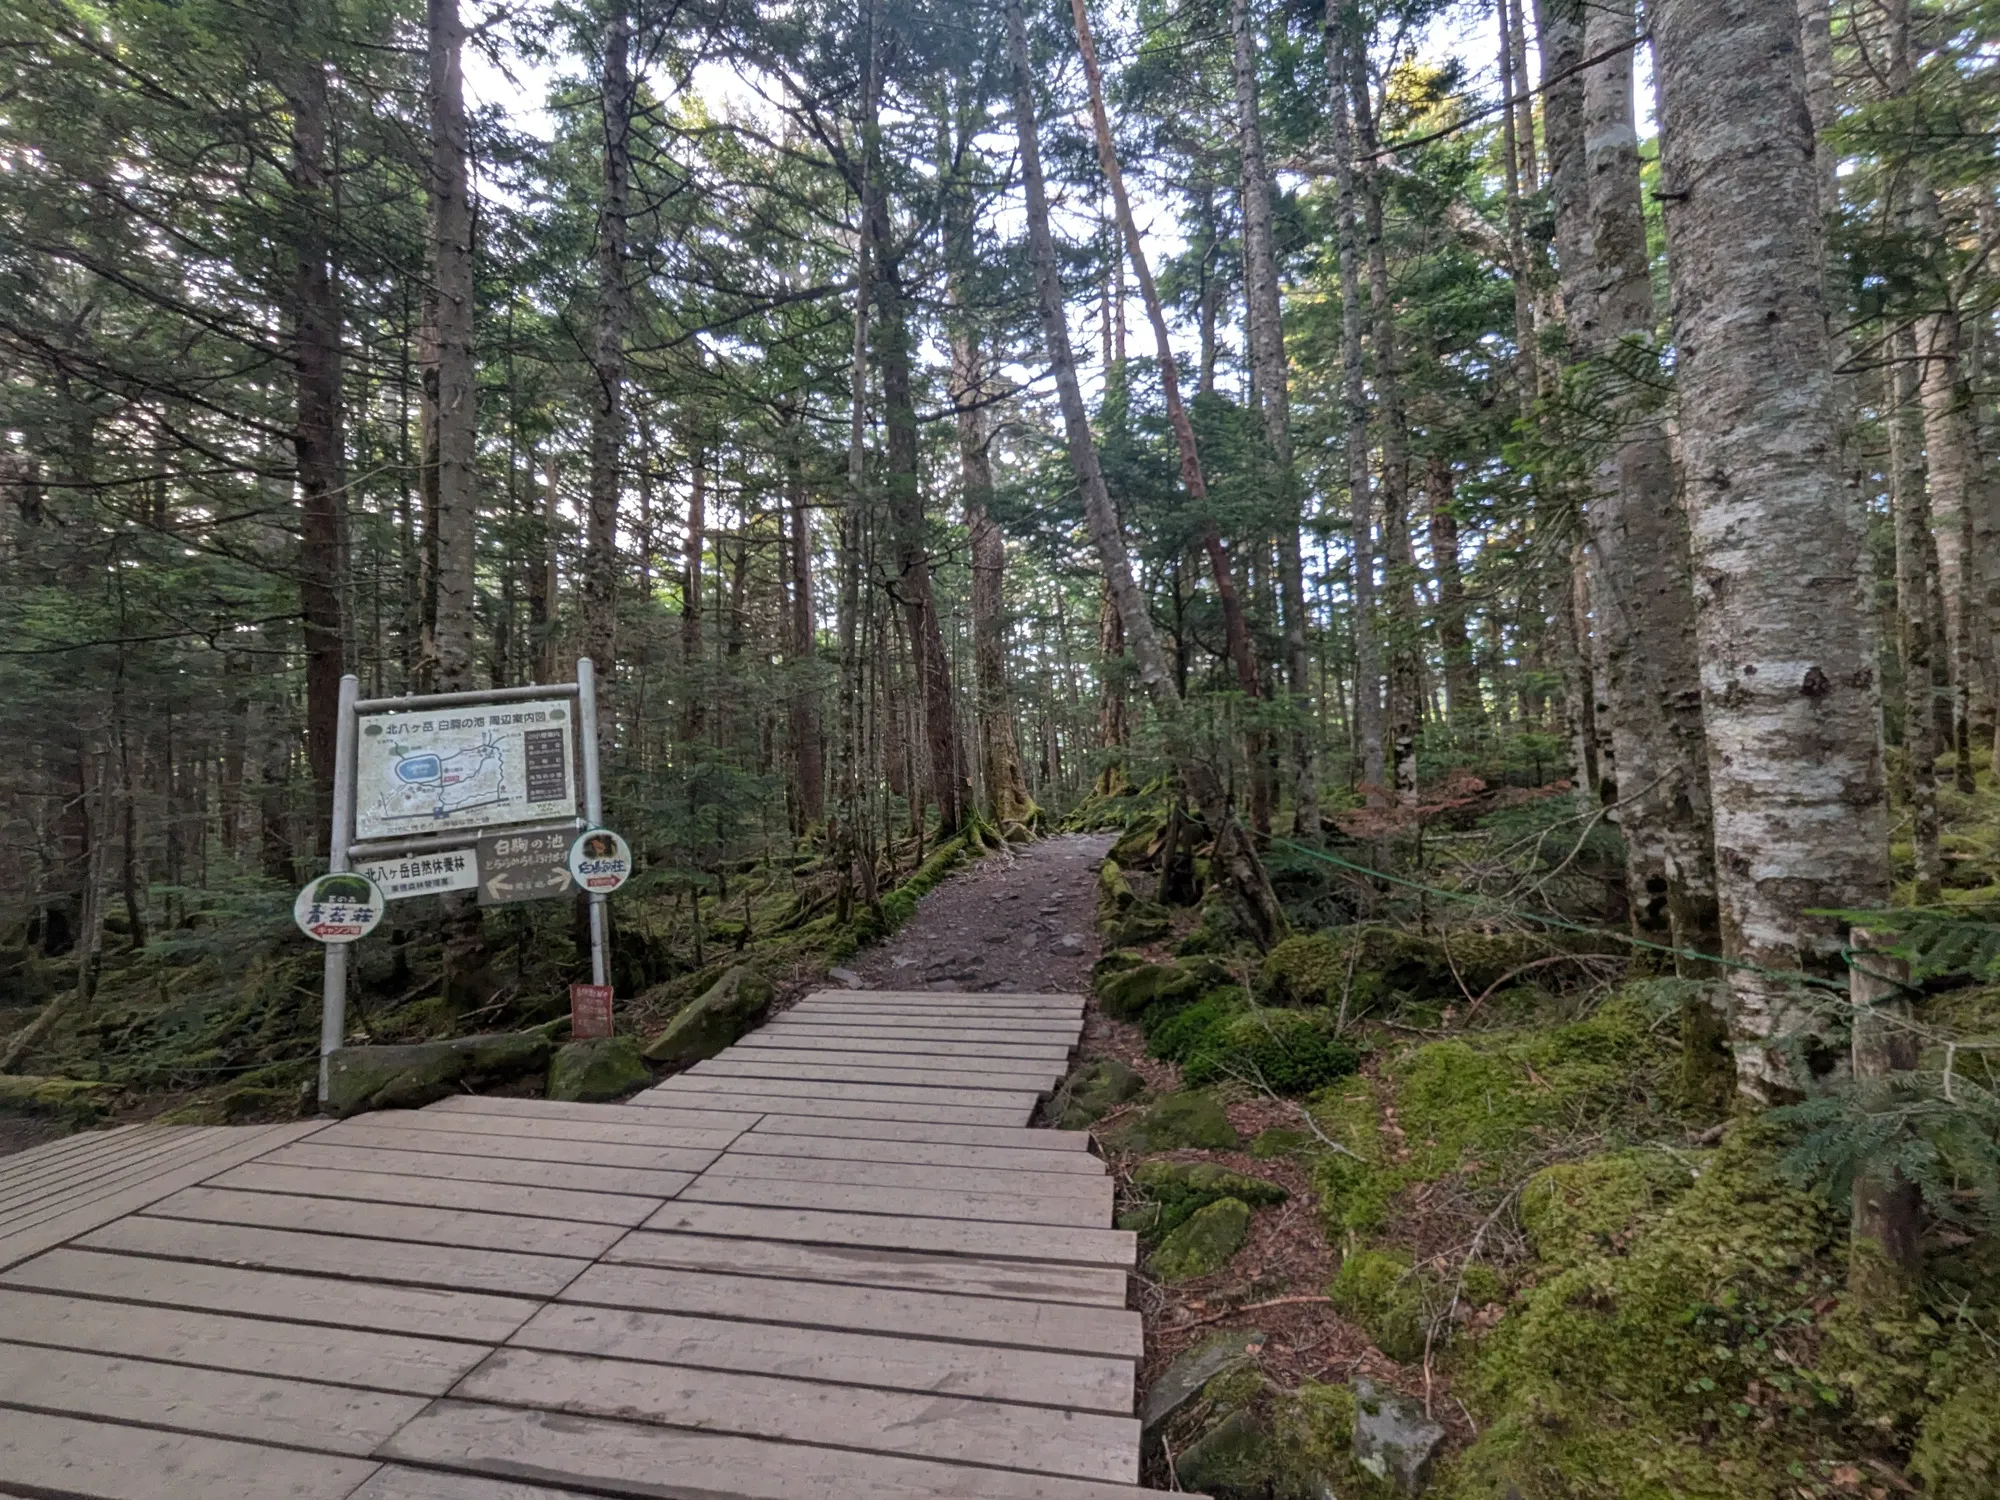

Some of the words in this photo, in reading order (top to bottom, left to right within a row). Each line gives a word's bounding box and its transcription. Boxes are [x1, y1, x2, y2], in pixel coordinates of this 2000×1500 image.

[438, 717, 485, 731] 白駒の池
[489, 711, 546, 726] 周辺案内図
[494, 834, 564, 855] 白駒の池
